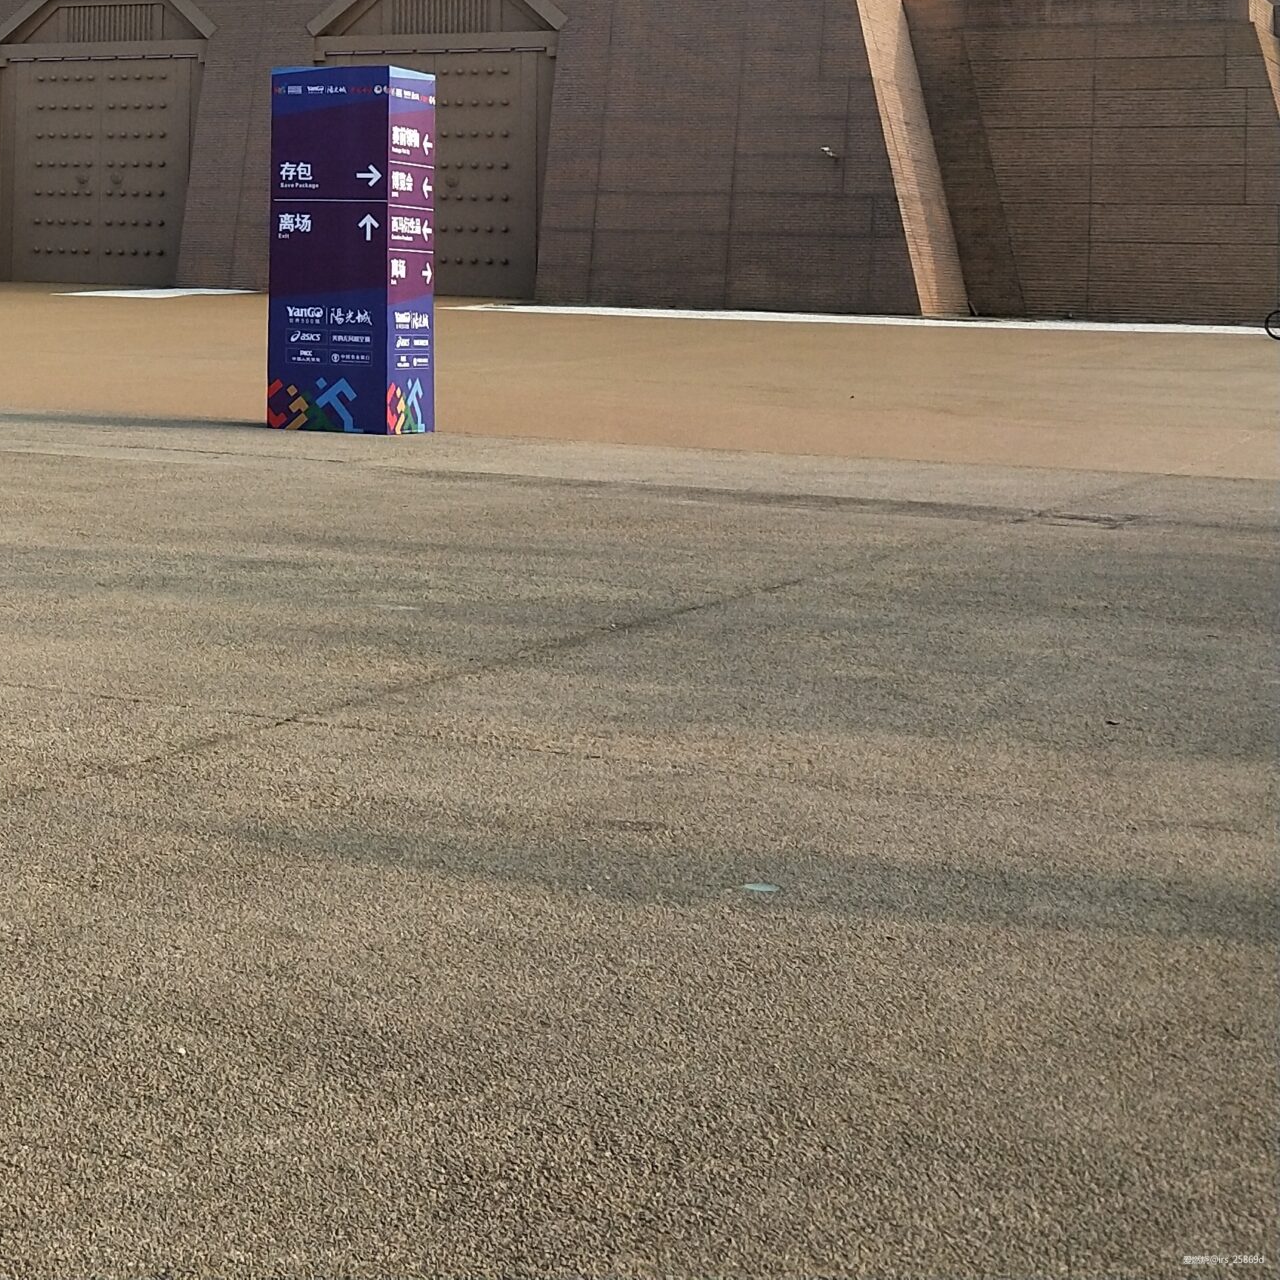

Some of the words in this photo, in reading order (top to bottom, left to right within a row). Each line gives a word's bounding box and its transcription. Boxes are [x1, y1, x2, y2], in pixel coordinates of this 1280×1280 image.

[279, 162, 313, 181] 存包
[295, 182, 319, 190] Package
[278, 213, 312, 233] 离场
